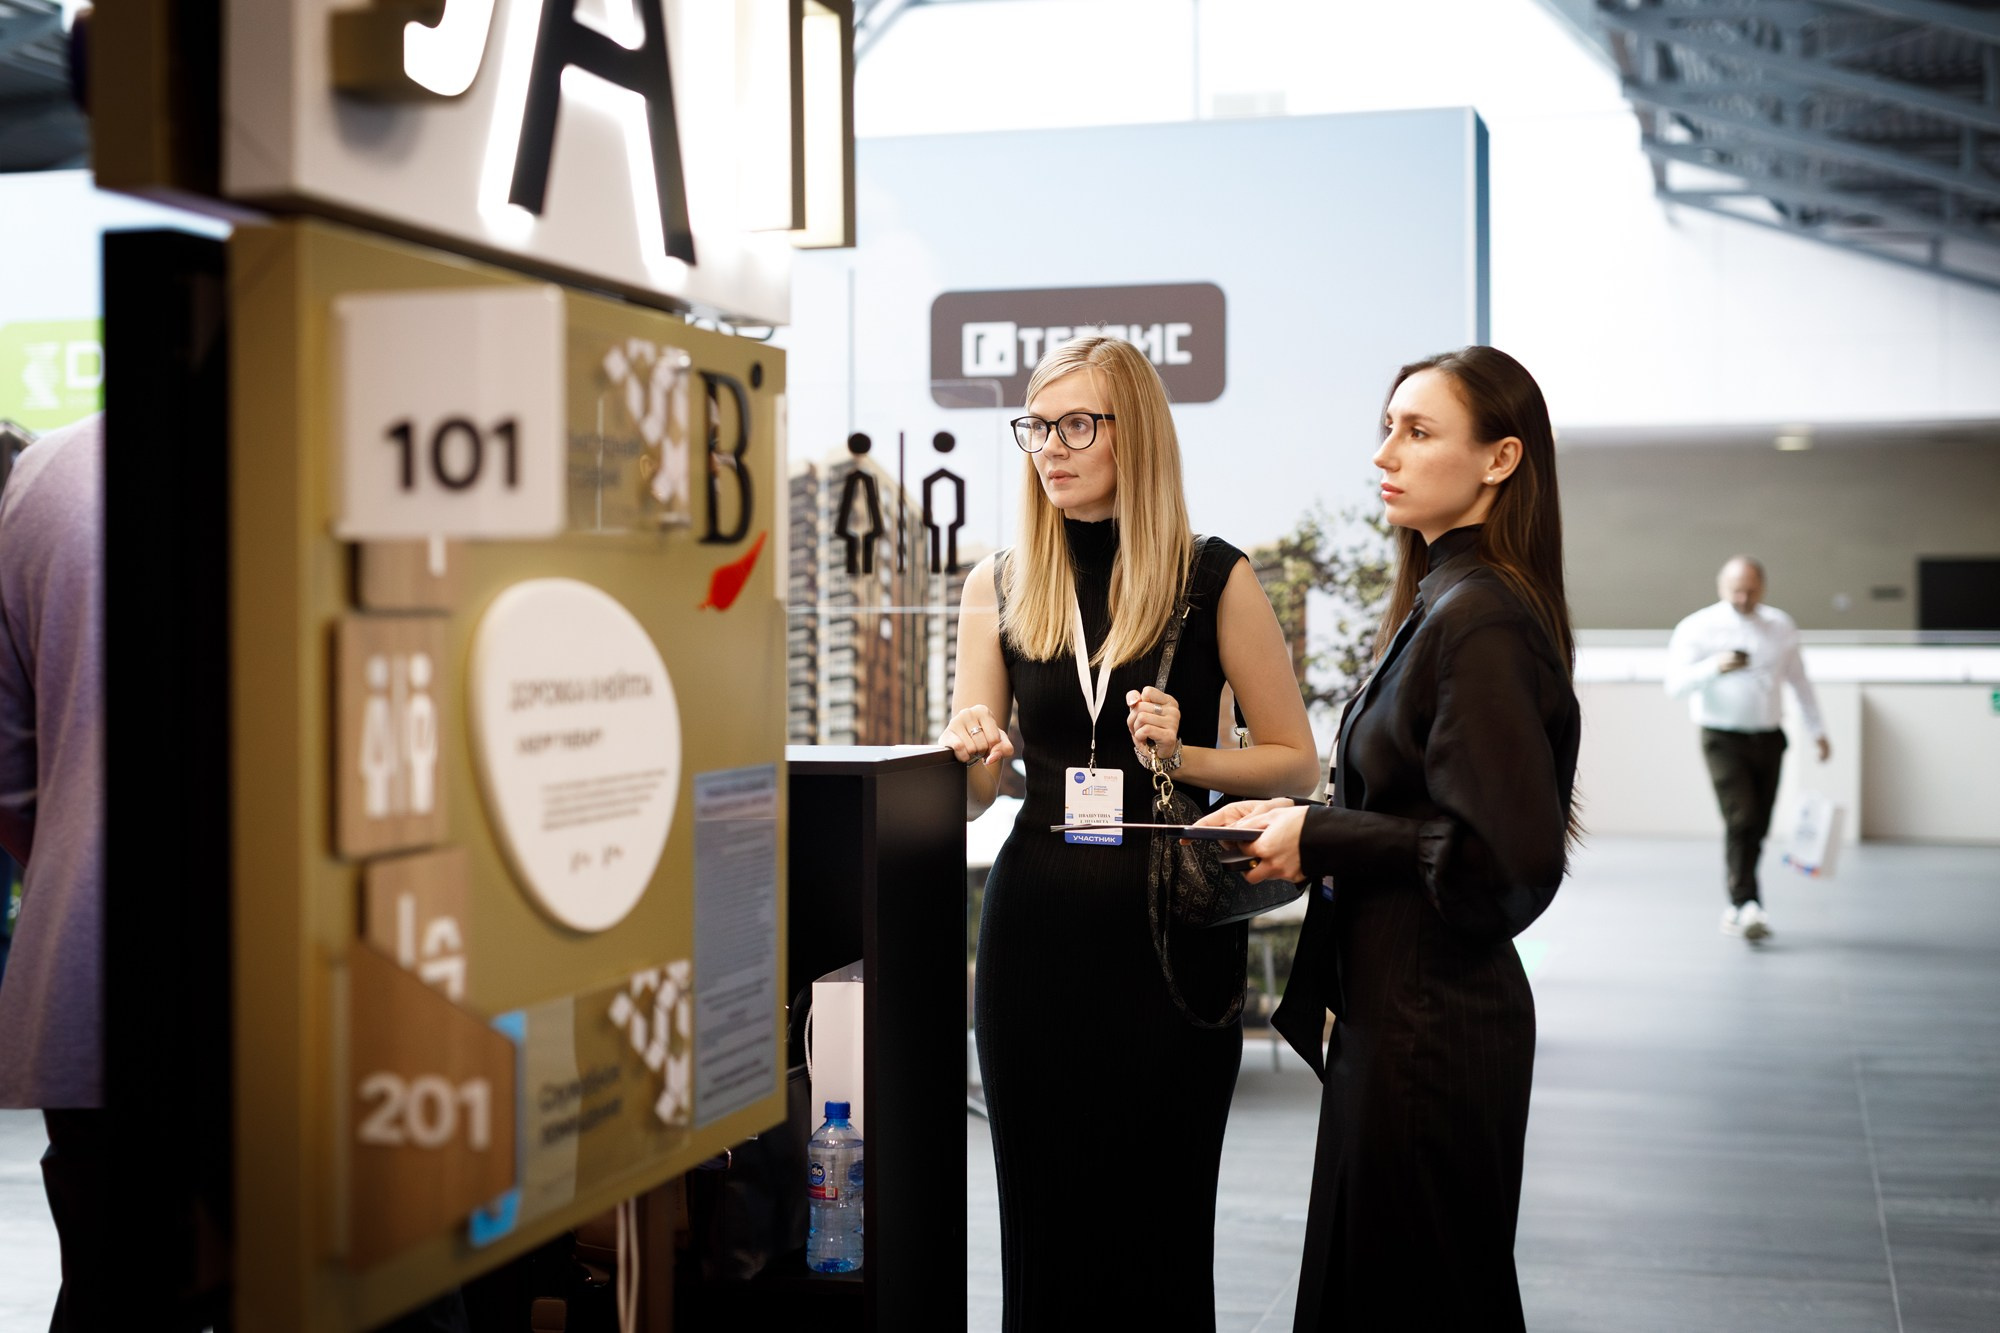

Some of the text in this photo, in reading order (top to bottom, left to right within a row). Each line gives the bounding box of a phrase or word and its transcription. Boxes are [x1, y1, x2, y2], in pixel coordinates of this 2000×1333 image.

[386, 417, 521, 492] 101
[1072, 834, 1116, 843] УЧАСТНИК
[357, 1071, 491, 1149] 201
